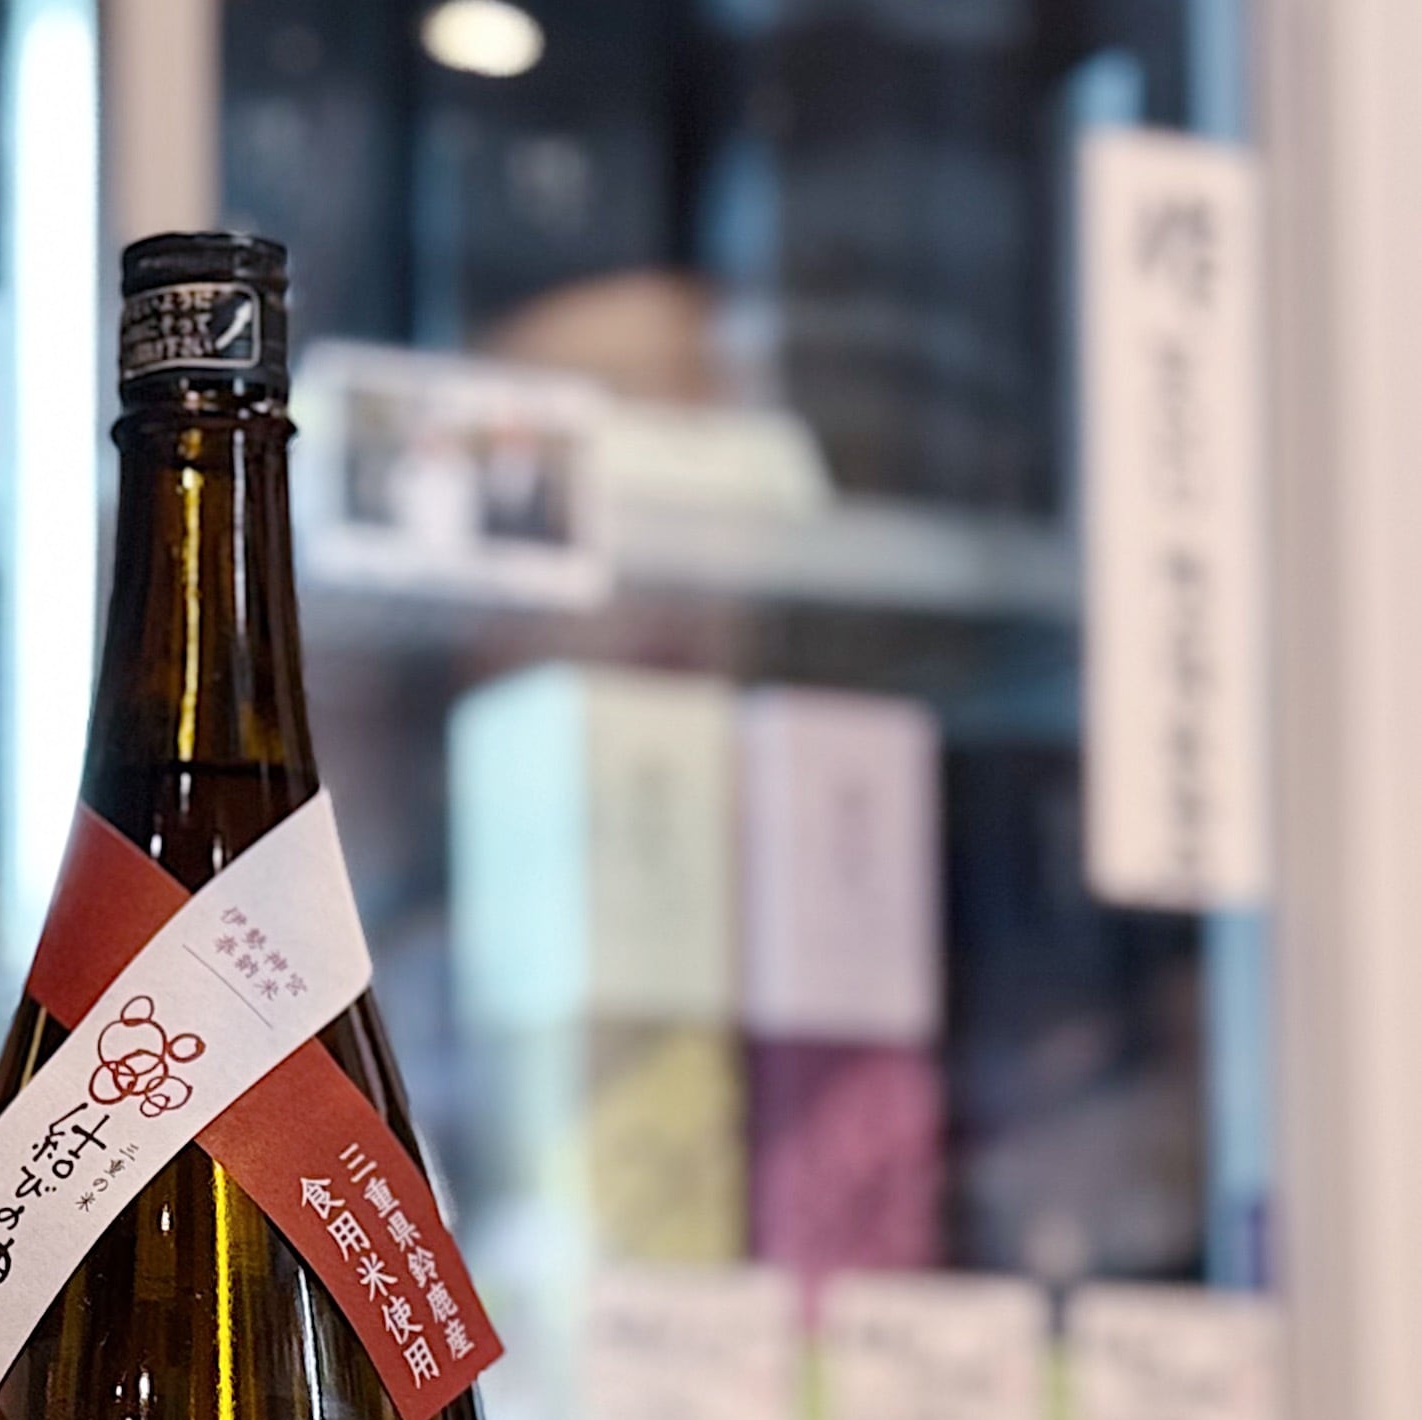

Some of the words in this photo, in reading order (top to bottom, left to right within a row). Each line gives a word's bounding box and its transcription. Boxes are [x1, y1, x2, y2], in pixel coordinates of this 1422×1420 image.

[76, 1143, 140, 1212] 三重の米
[300, 1177, 441, 1390] 食用米使用
[339, 1143, 475, 1362] 三重県鈴鹿産
